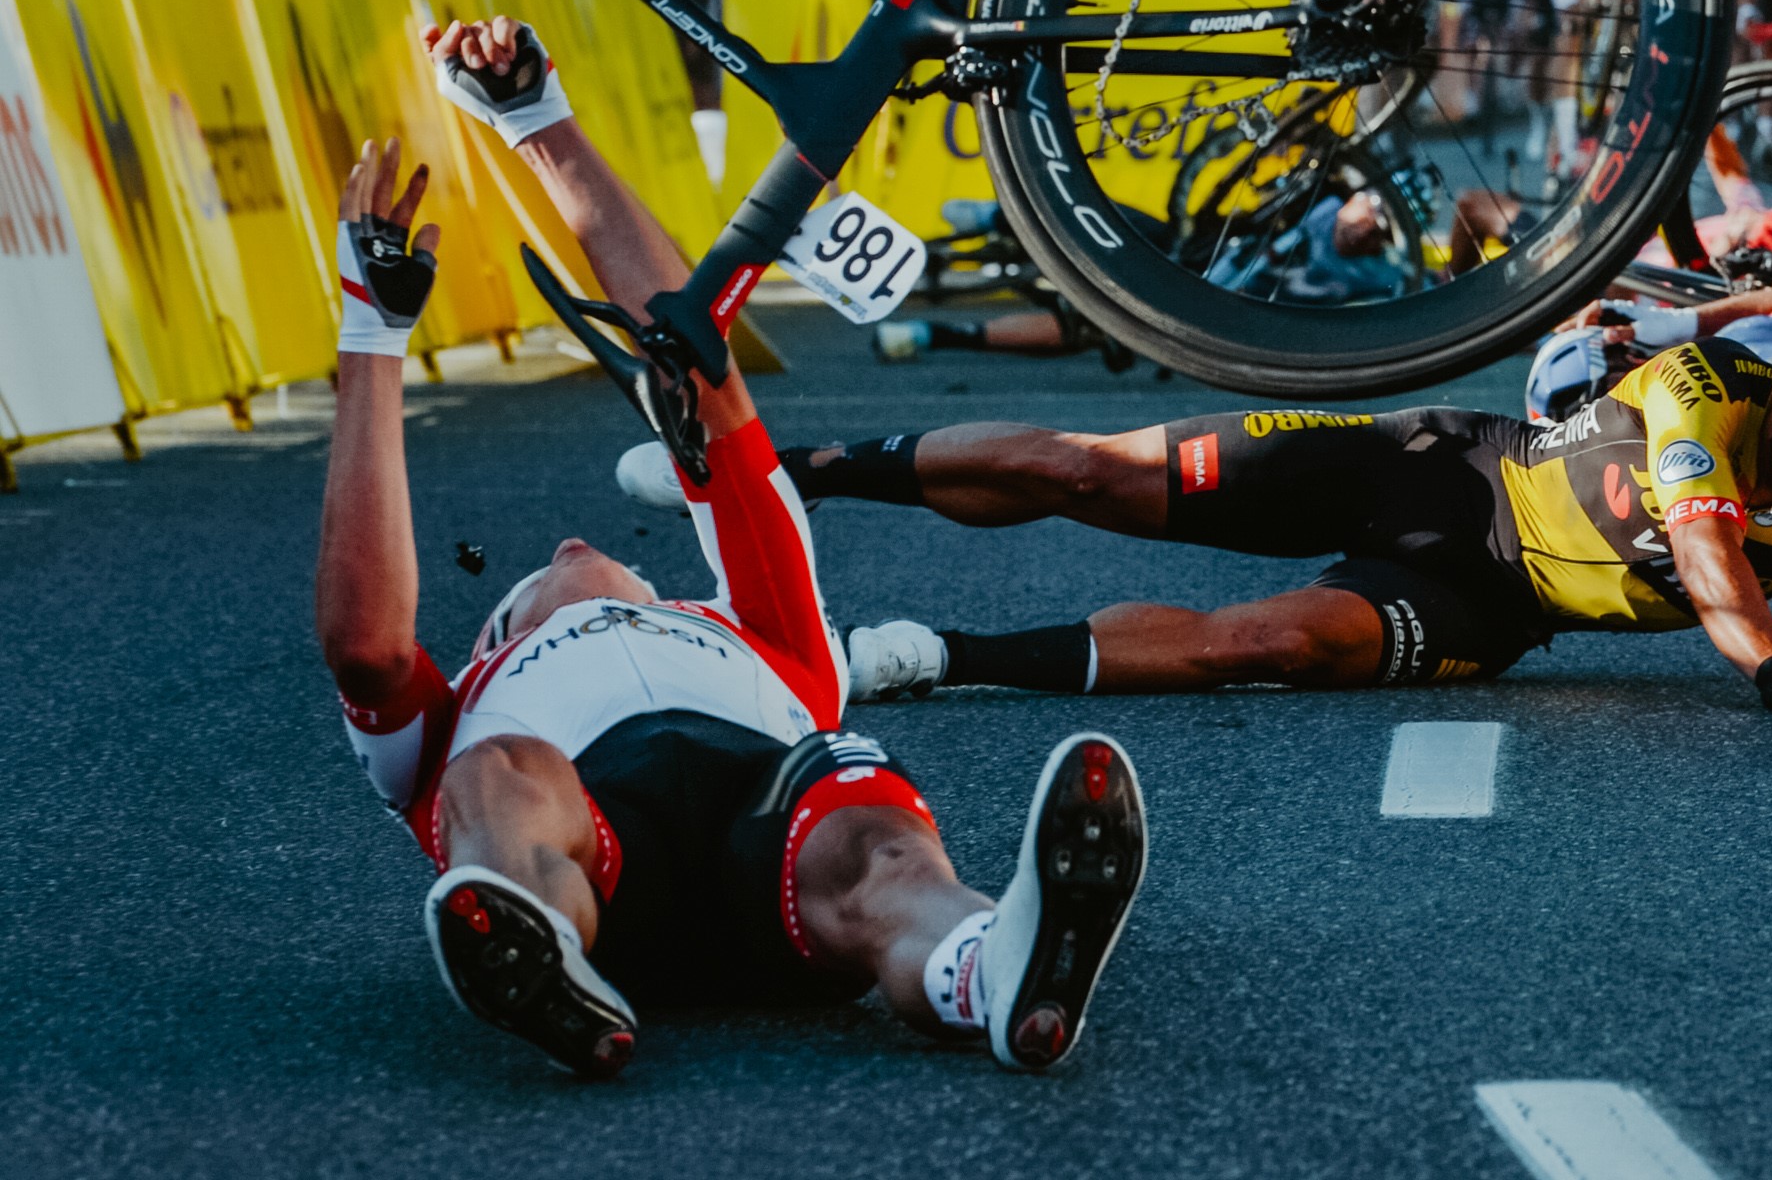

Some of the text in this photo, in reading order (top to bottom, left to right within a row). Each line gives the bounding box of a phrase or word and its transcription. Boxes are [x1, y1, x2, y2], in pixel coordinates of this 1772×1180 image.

[814, 206, 917, 301] 186
[717, 268, 754, 317] COLNAGO
[1659, 361, 1701, 412] VISMA
[1672, 347, 1723, 404] MBO
[1192, 439, 1206, 487] HEMA
[1665, 498, 1740, 525] HEMA
